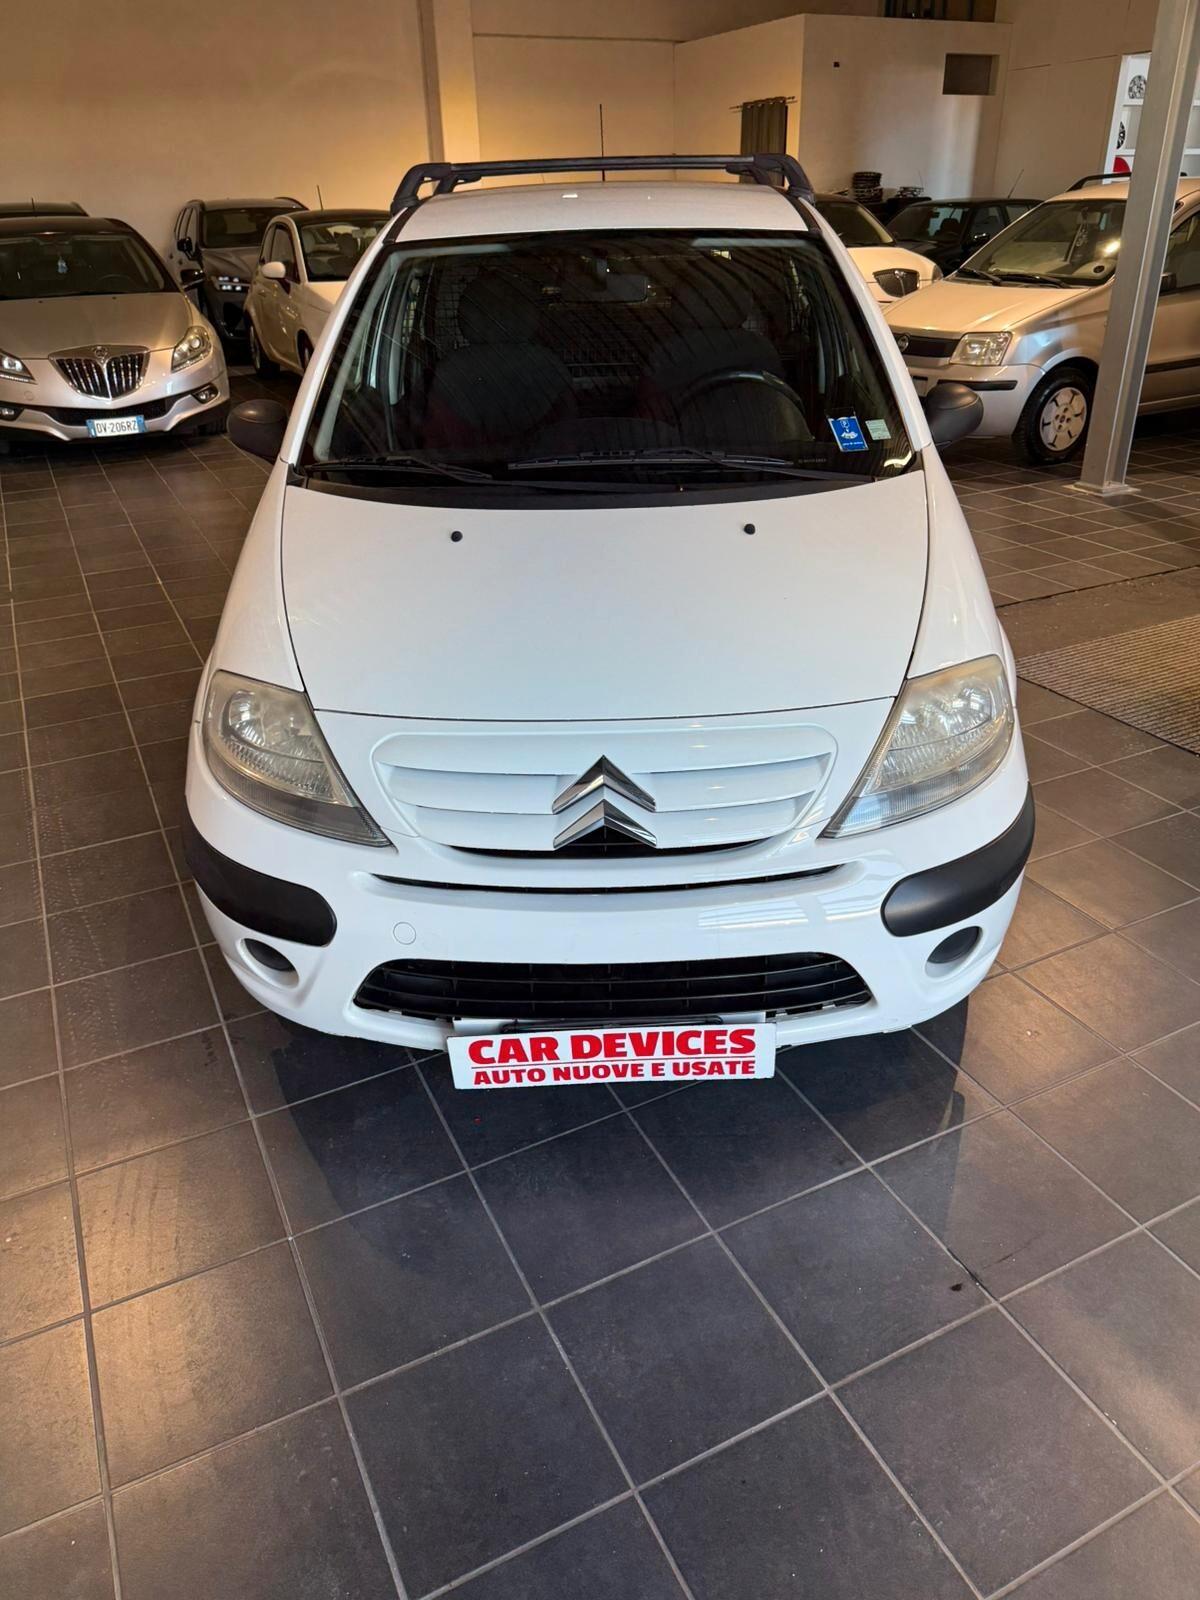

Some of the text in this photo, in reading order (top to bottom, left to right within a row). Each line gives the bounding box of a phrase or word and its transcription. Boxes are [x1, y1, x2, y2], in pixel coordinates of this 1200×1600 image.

[468, 1029, 756, 1065] CAR DEVICES
[473, 1060, 755, 1085] AUTO NUOVE E USATE
